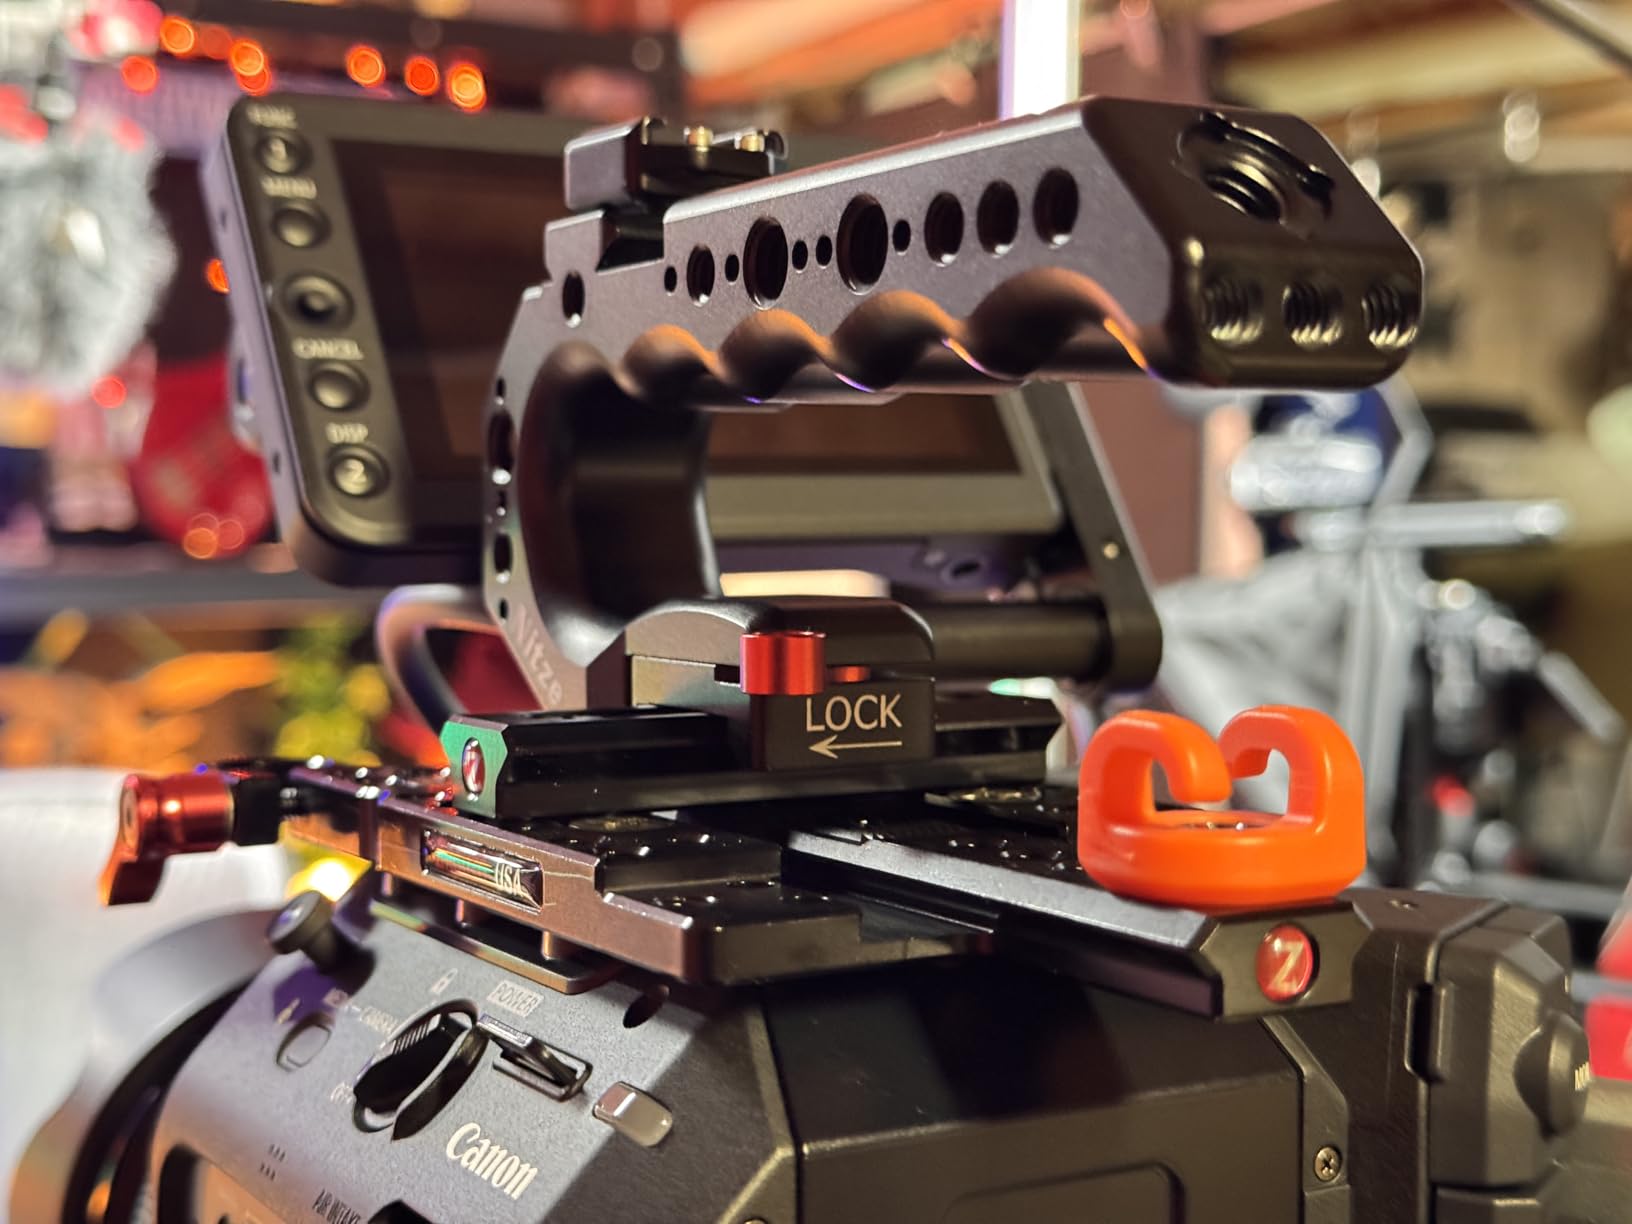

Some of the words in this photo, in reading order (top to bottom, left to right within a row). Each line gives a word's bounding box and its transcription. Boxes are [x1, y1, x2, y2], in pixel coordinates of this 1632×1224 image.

[292, 337, 365, 360] CANCEL
[326, 422, 368, 444] DISP
[346, 458, 367, 484] 2
[806, 693, 902, 731] LOCK
[495, 861, 522, 897] USA
[489, 981, 540, 1016] POWER
[446, 1122, 538, 1200] Canon
